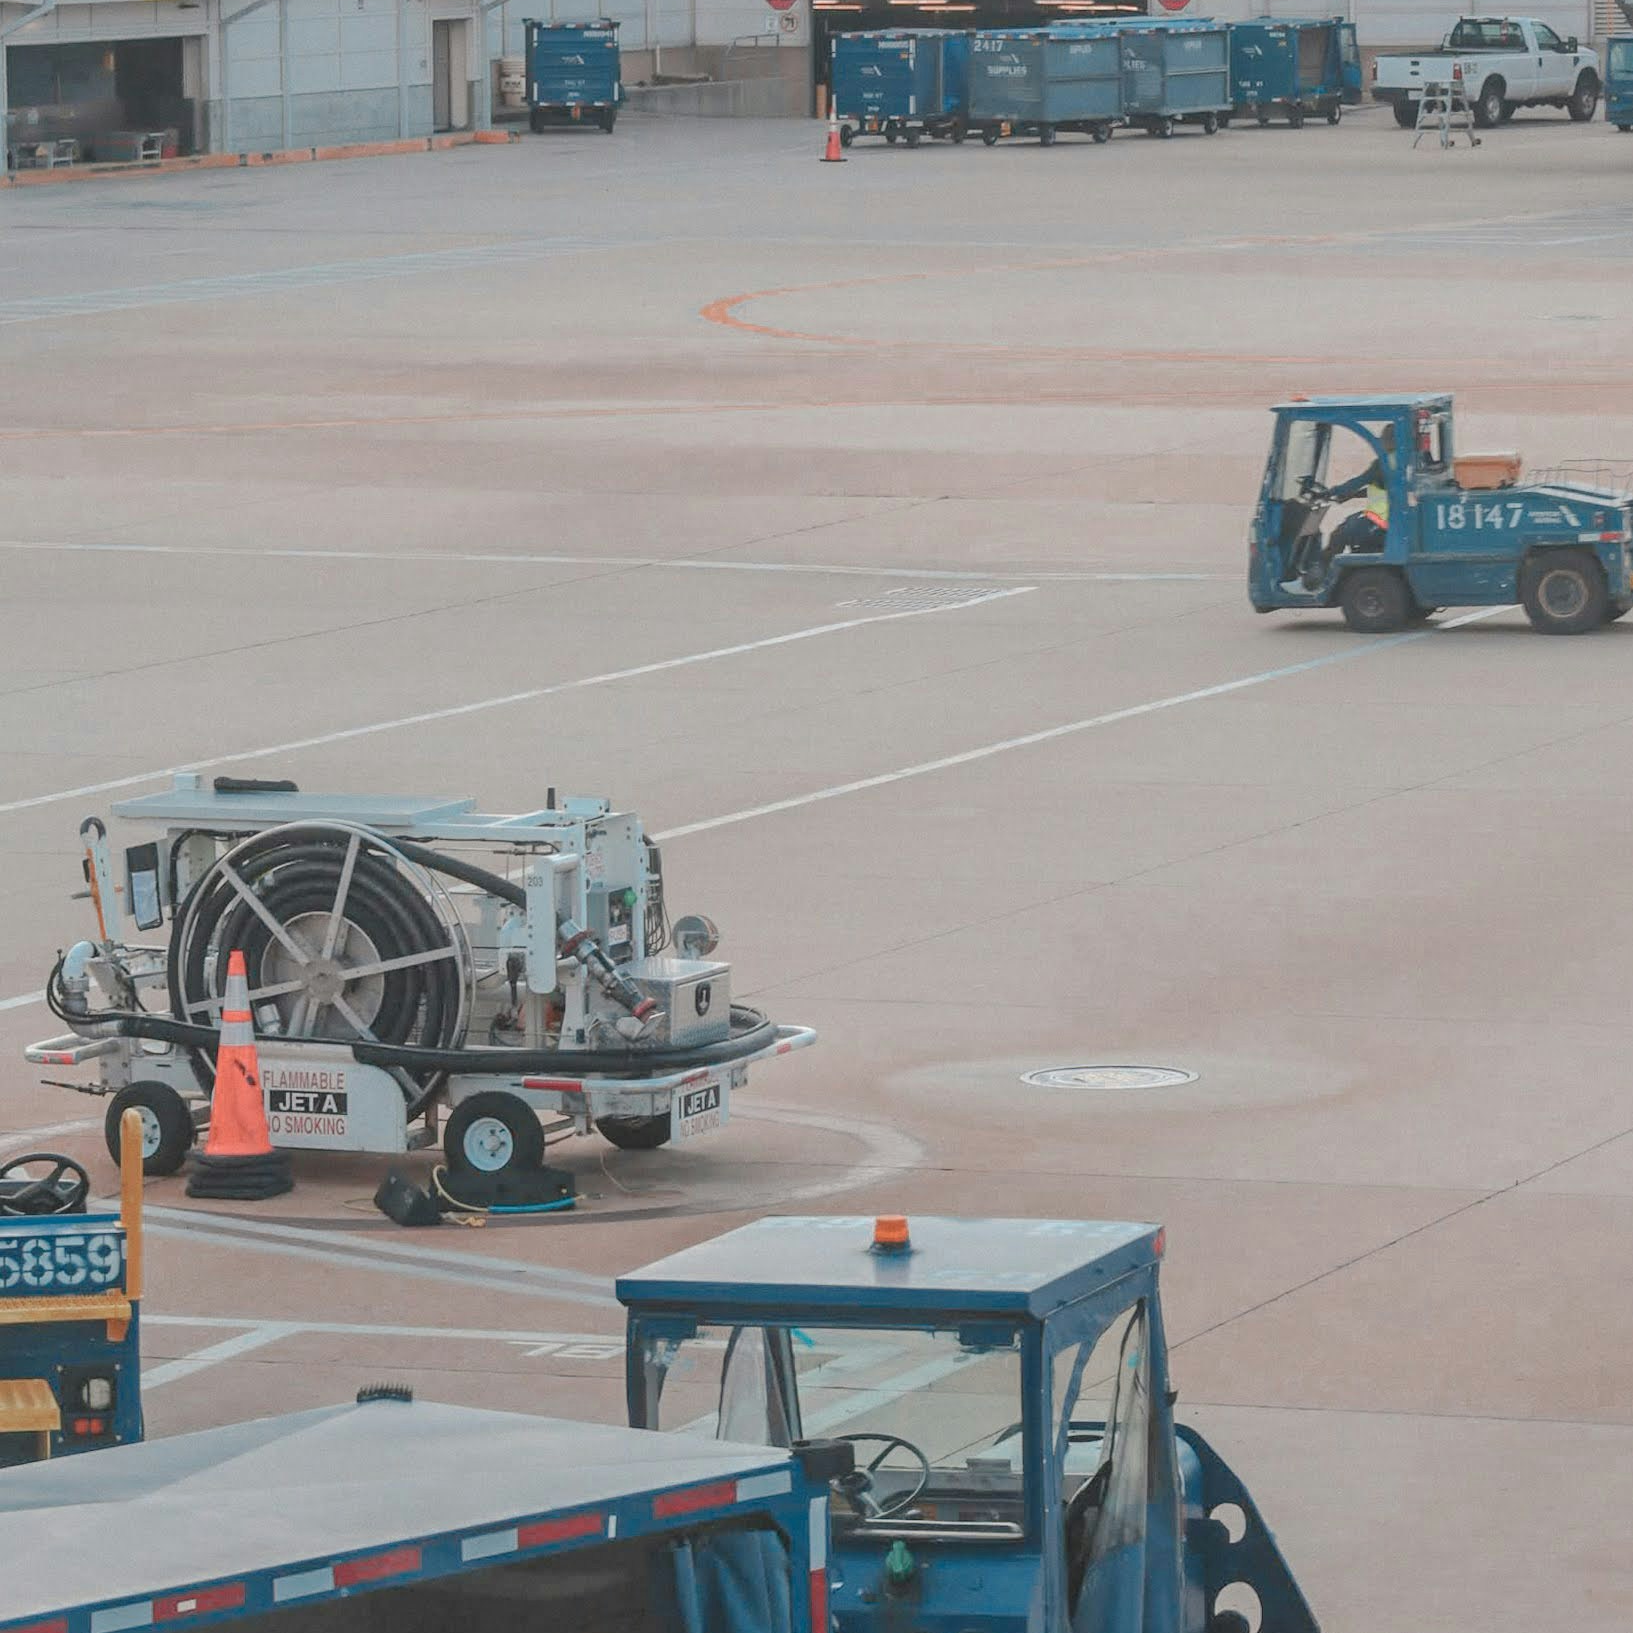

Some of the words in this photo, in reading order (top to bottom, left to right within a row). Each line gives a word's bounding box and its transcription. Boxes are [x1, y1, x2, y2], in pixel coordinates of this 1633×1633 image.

[974, 40, 1003, 52] 2417
[1437, 503, 1524, 530] 18147
[527, 876, 544, 887] 203
[263, 1070, 345, 1090] FLAMMABLE
[278, 1092, 319, 1112] JET
[322, 1094, 338, 1113] A
[687, 1090, 707, 1115] JET
[707, 1089, 717, 1109] A
[285, 1115, 345, 1136] SMOKING
